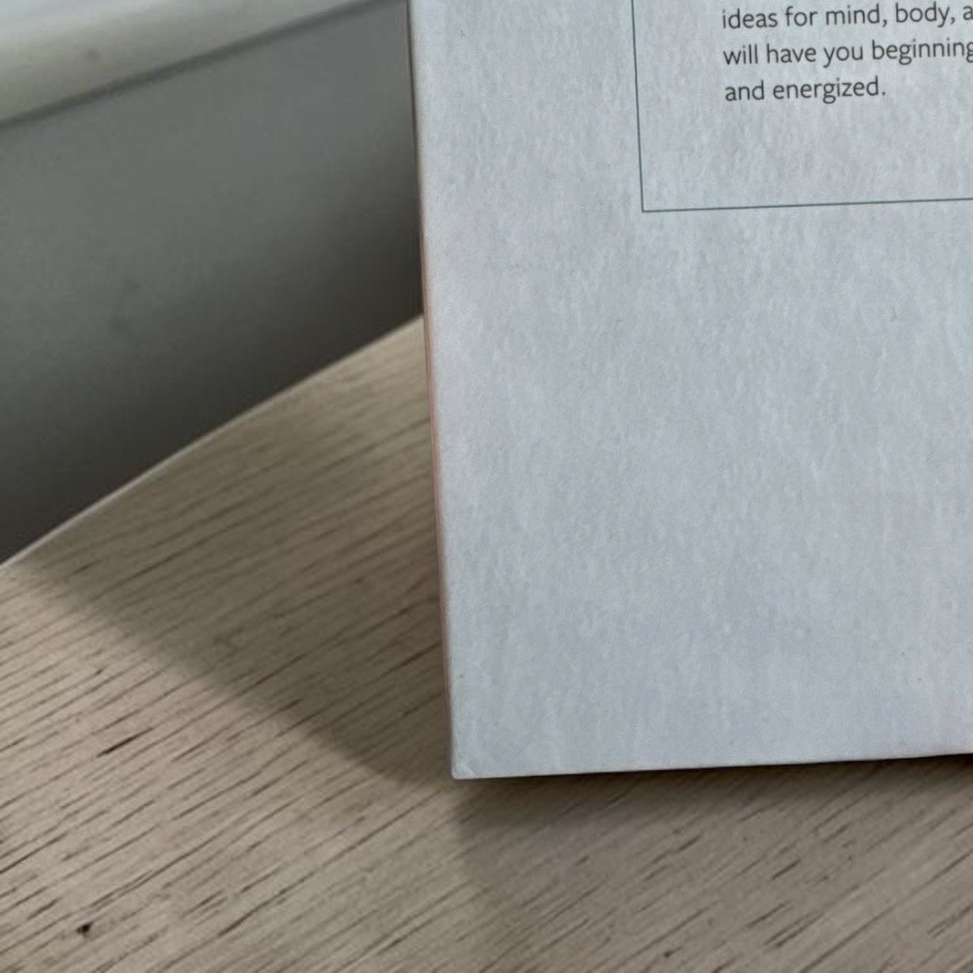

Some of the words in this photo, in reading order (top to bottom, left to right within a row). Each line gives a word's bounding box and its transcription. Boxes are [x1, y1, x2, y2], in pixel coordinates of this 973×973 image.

[722, 8, 778, 29] ideas
[784, 5, 818, 27] for
[826, 3, 887, 27] mind,
[895, 1, 955, 28] body,
[723, 43, 758, 65] will
[766, 43, 817, 64] have
[823, 45, 863, 69] you
[725, 79, 765, 102] and
[773, 75, 886, 104] energized.
